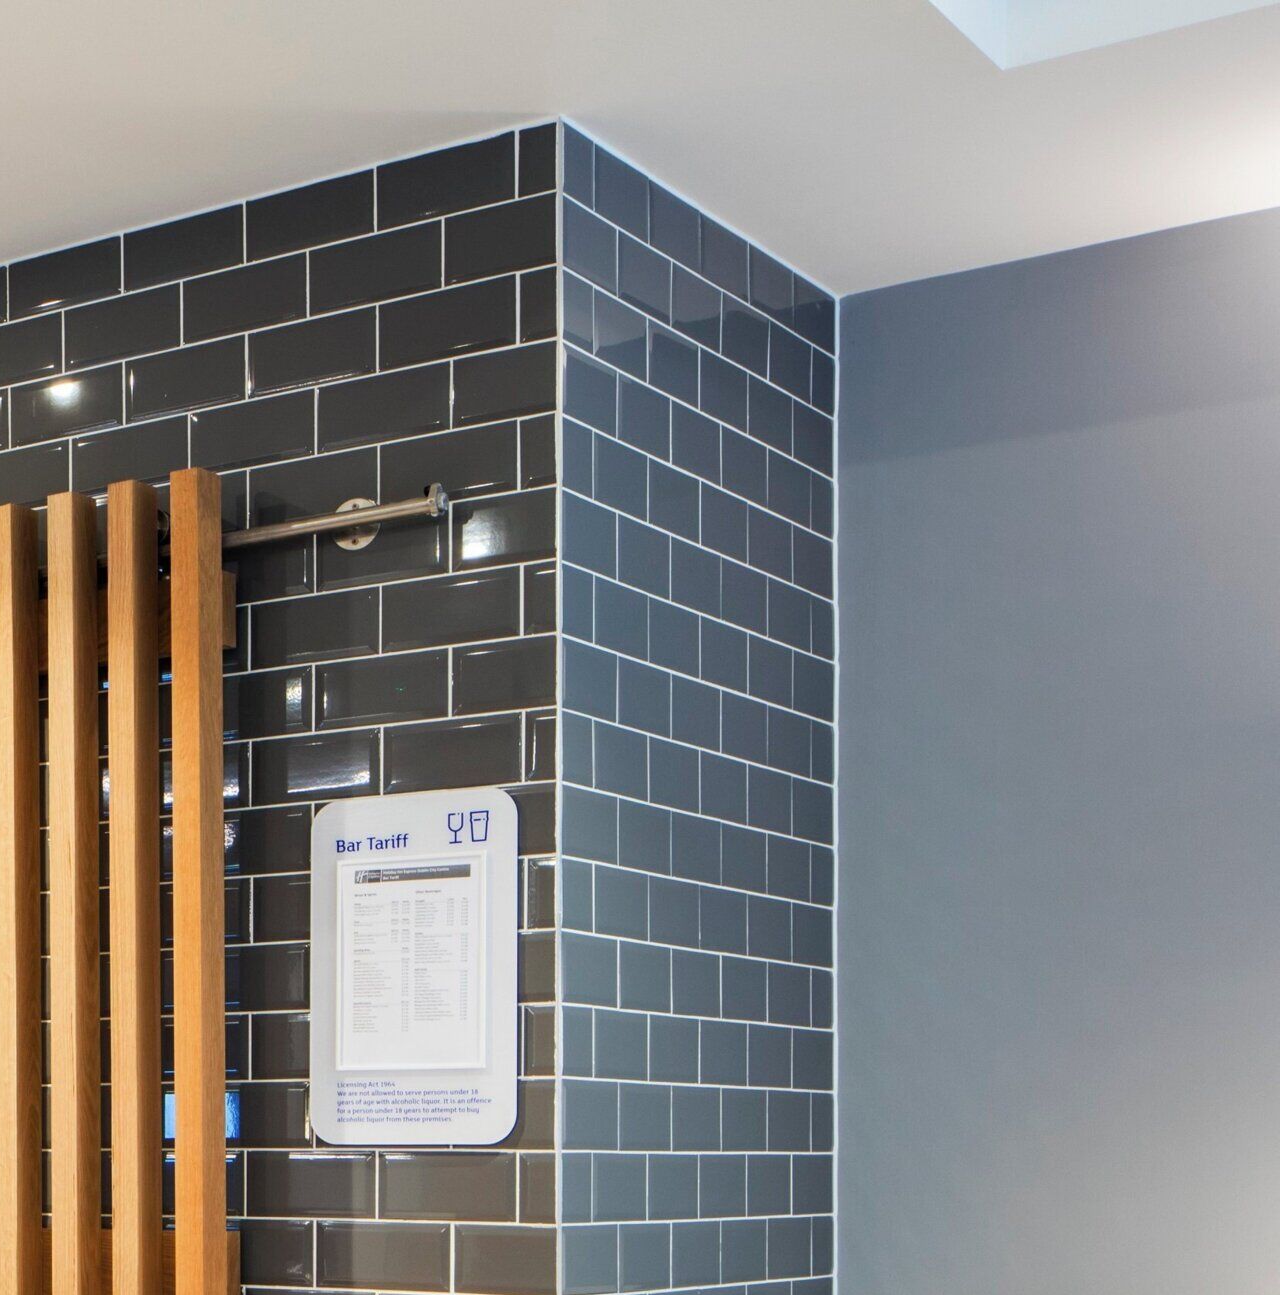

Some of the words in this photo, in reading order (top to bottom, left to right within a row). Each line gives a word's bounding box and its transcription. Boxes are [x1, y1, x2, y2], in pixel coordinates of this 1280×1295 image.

[336, 839, 362, 853] Bar
[367, 833, 409, 851] Tariff
[466, 1096, 492, 1104] offence
[466, 1106, 480, 1114] buy
